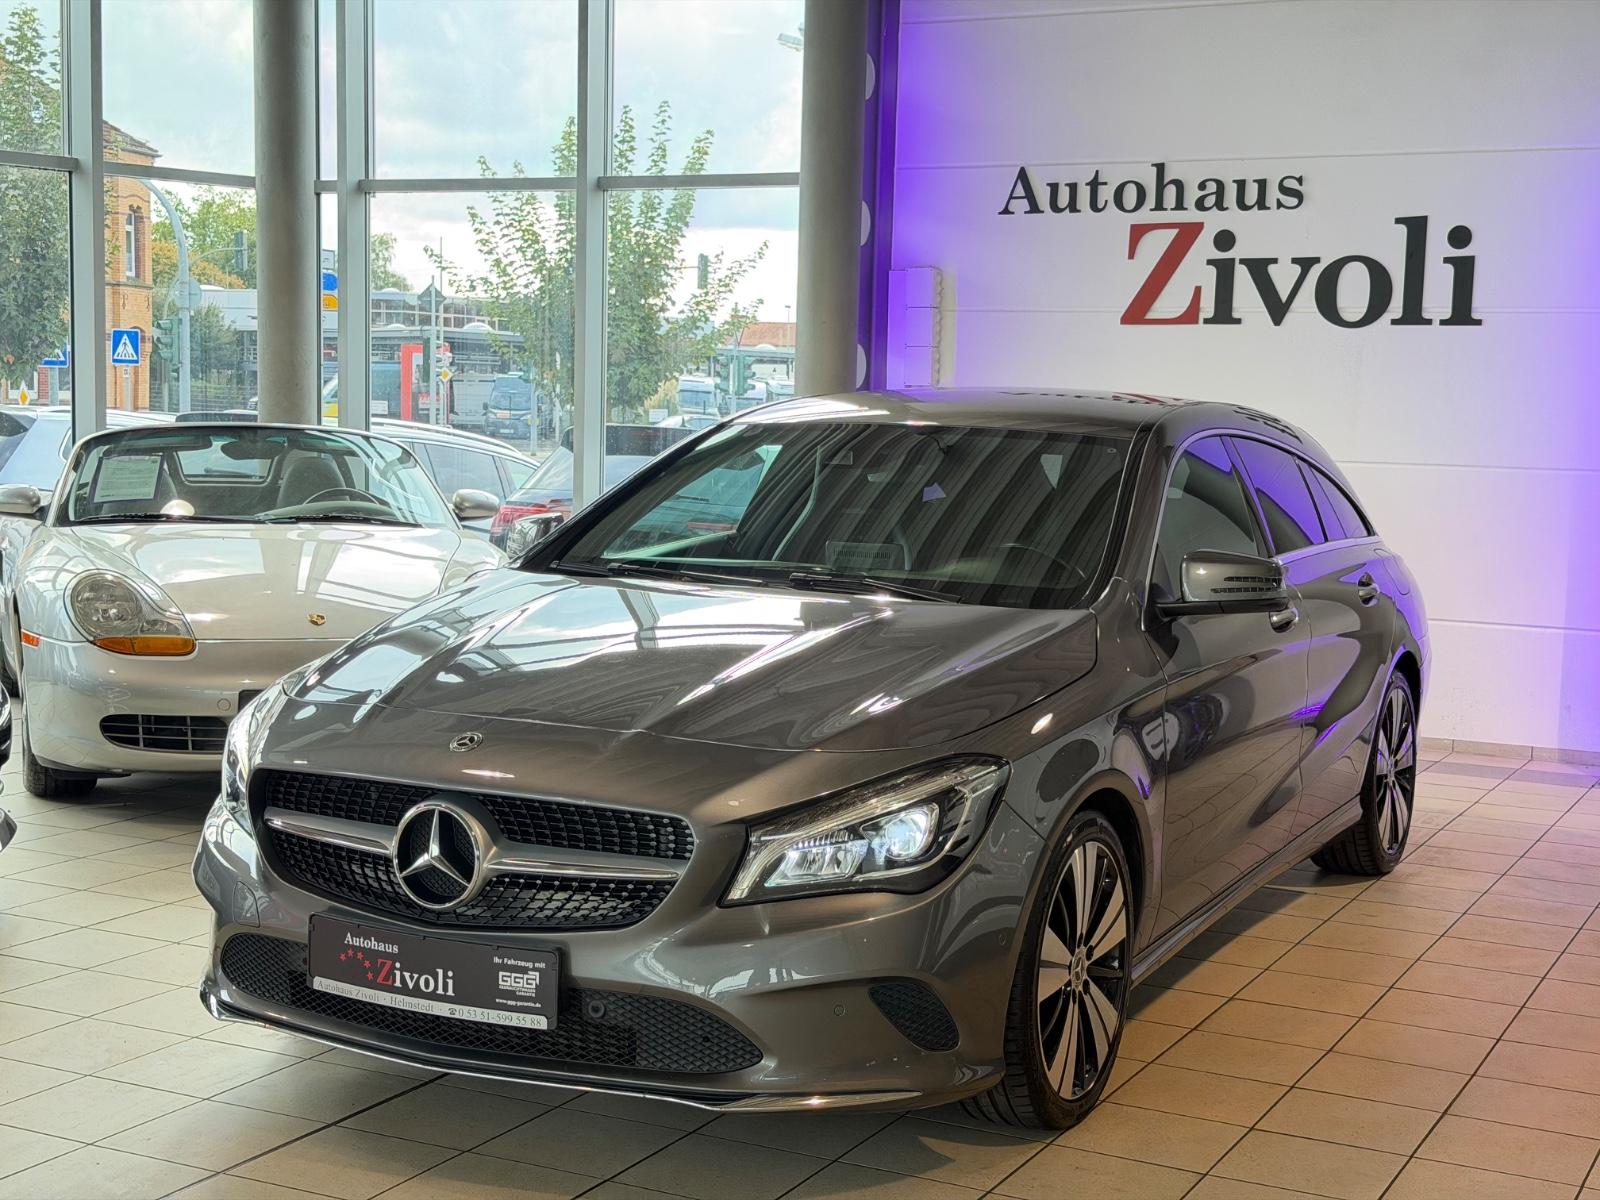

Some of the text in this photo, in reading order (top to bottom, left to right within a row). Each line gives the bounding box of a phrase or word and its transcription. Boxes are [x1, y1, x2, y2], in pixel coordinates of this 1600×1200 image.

[998, 162, 1305, 215] Autohaus
[1119, 215, 1483, 329] Zivoli
[344, 931, 399, 953] Autohaus
[493, 956, 546, 969] Ihr Fahrzeug mit
[376, 958, 455, 996] Zivoli
[317, 980, 354, 997] Autohaus
[354, 988, 380, 1003] Zivoli
[390, 995, 434, 1013] Helmstedt
[467, 1009, 477, 1018] 53
[480, 1011, 513, 1023] 51-599
[515, 1016, 527, 1026] 55
[530, 1017, 542, 1027] 88
